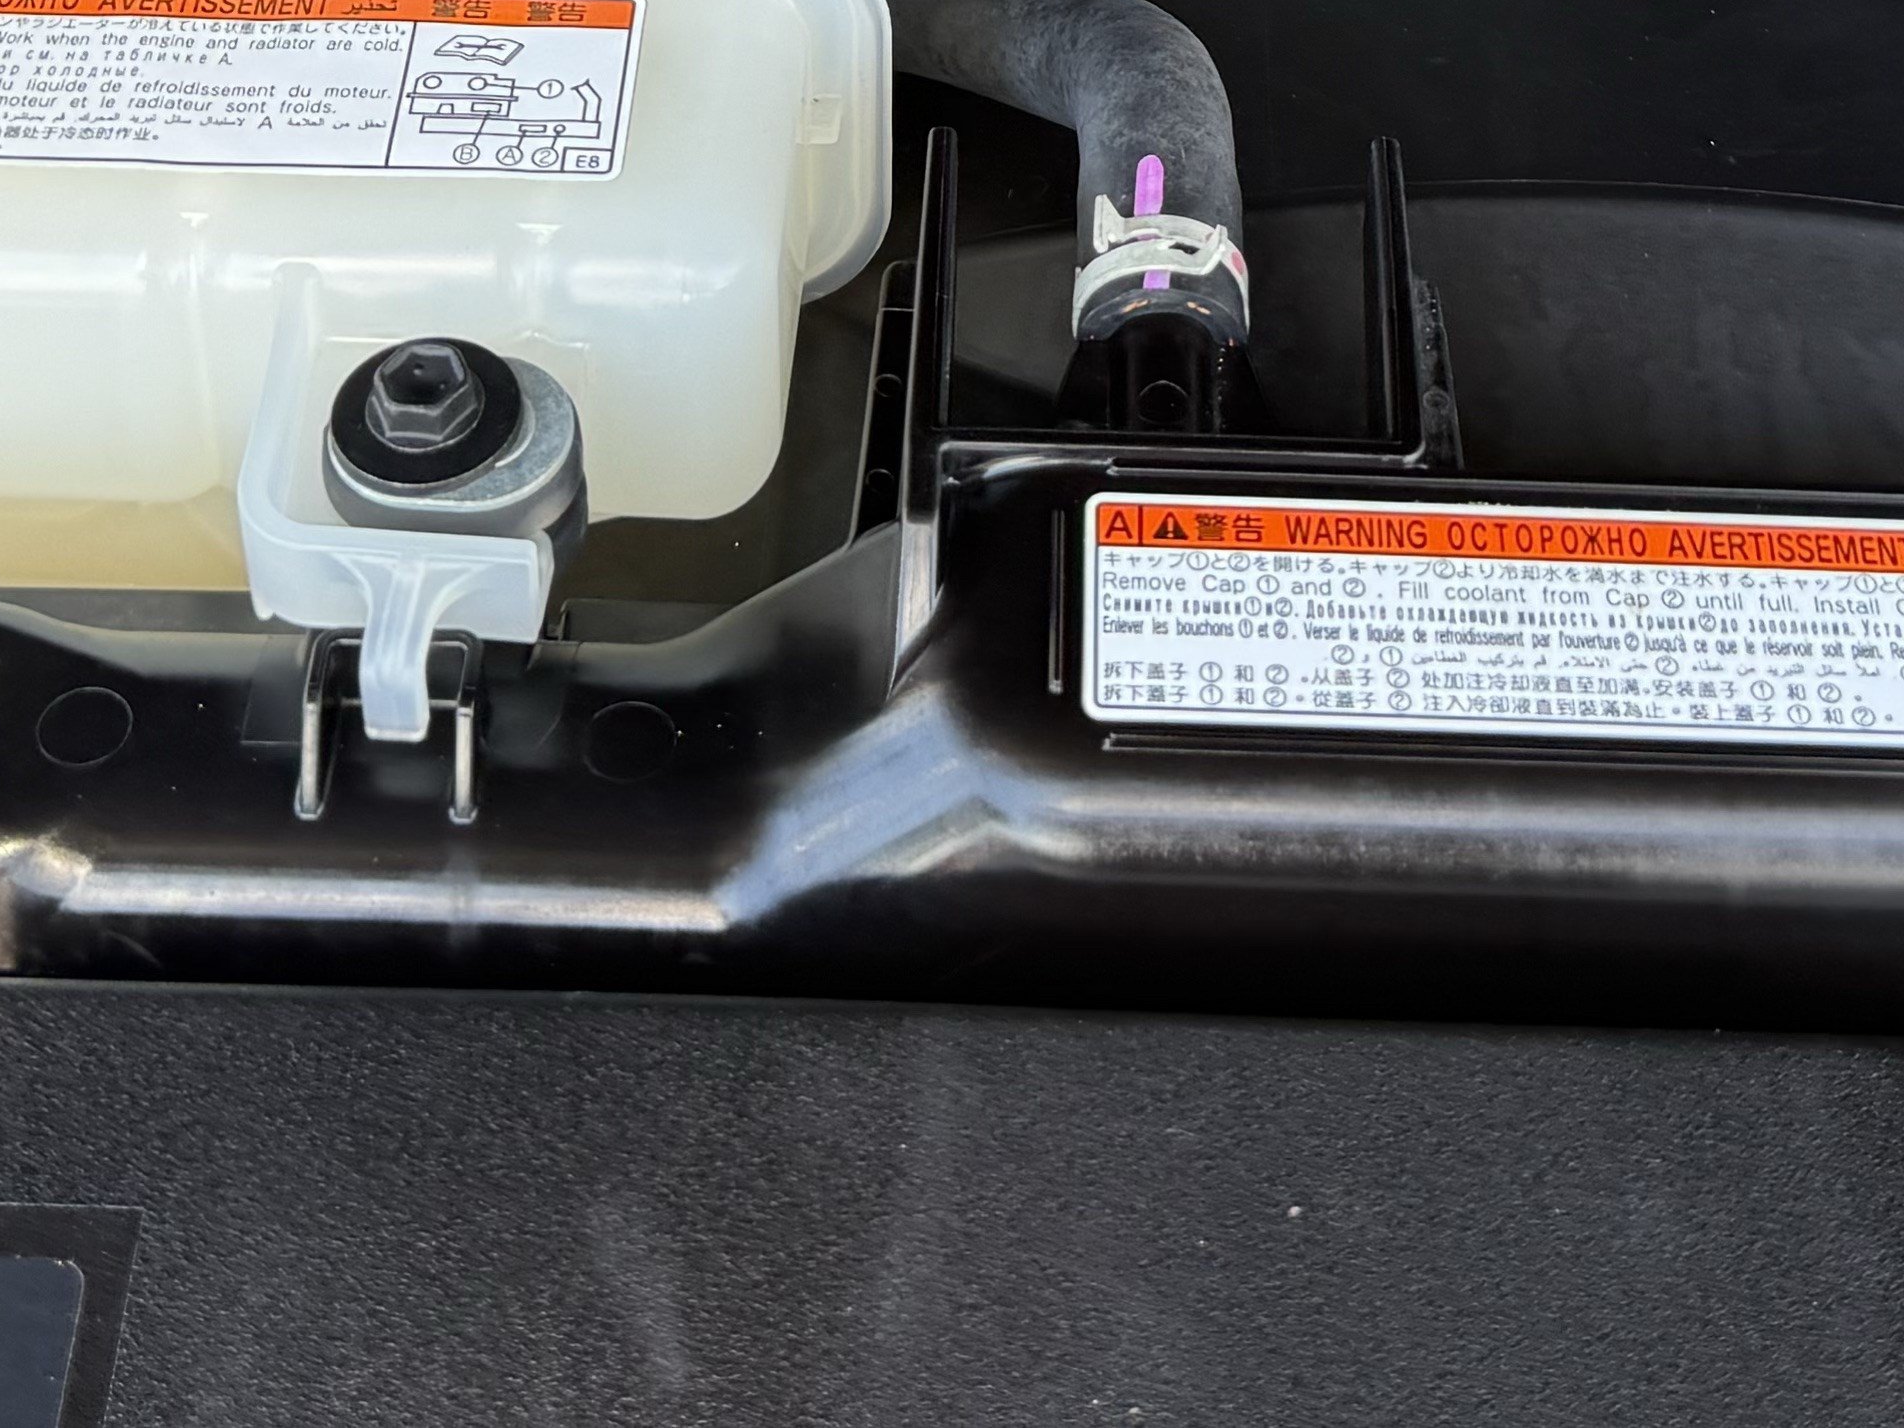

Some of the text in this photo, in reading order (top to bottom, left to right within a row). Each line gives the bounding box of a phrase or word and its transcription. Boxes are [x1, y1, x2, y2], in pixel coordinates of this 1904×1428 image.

[525, 1, 588, 21] 警告
[46, 32, 90, 46] when
[101, 32, 128, 46] the
[138, 34, 195, 49] engine
[205, 37, 239, 50] and
[249, 37, 315, 50] radiator
[326, 39, 353, 51] are
[364, 38, 403, 52] cold.
[26, 78, 87, 93] liquide
[99, 79, 122, 93] de
[134, 81, 275, 97] refroidissement
[288, 84, 312, 98] du
[324, 87, 391, 99] moteur.
[69, 96, 88, 109] et
[99, 95, 116, 109] le
[127, 96, 213, 112] radiateur
[225, 101, 267, 113] sont
[279, 99, 336, 114] froids.
[575, 155, 600, 168] E8
[1105, 510, 1132, 539] A
[1195, 513, 1264, 542] 警告
[1285, 516, 1427, 549] WARNING
[1446, 521, 1648, 557] ОСТОРОЖНО
[1103, 571, 1186, 592] Remove
[1201, 574, 1246, 595] Cap
[1291, 579, 1332, 596] and
[1398, 580, 1429, 600] Fill
[1444, 585, 1526, 603] coolant
[1542, 586, 1590, 605] from
[1605, 588, 1650, 609] Cap
[1695, 592, 1743, 611] until
[1759, 593, 1799, 613] full.
[1814, 594, 1880, 615] Install
